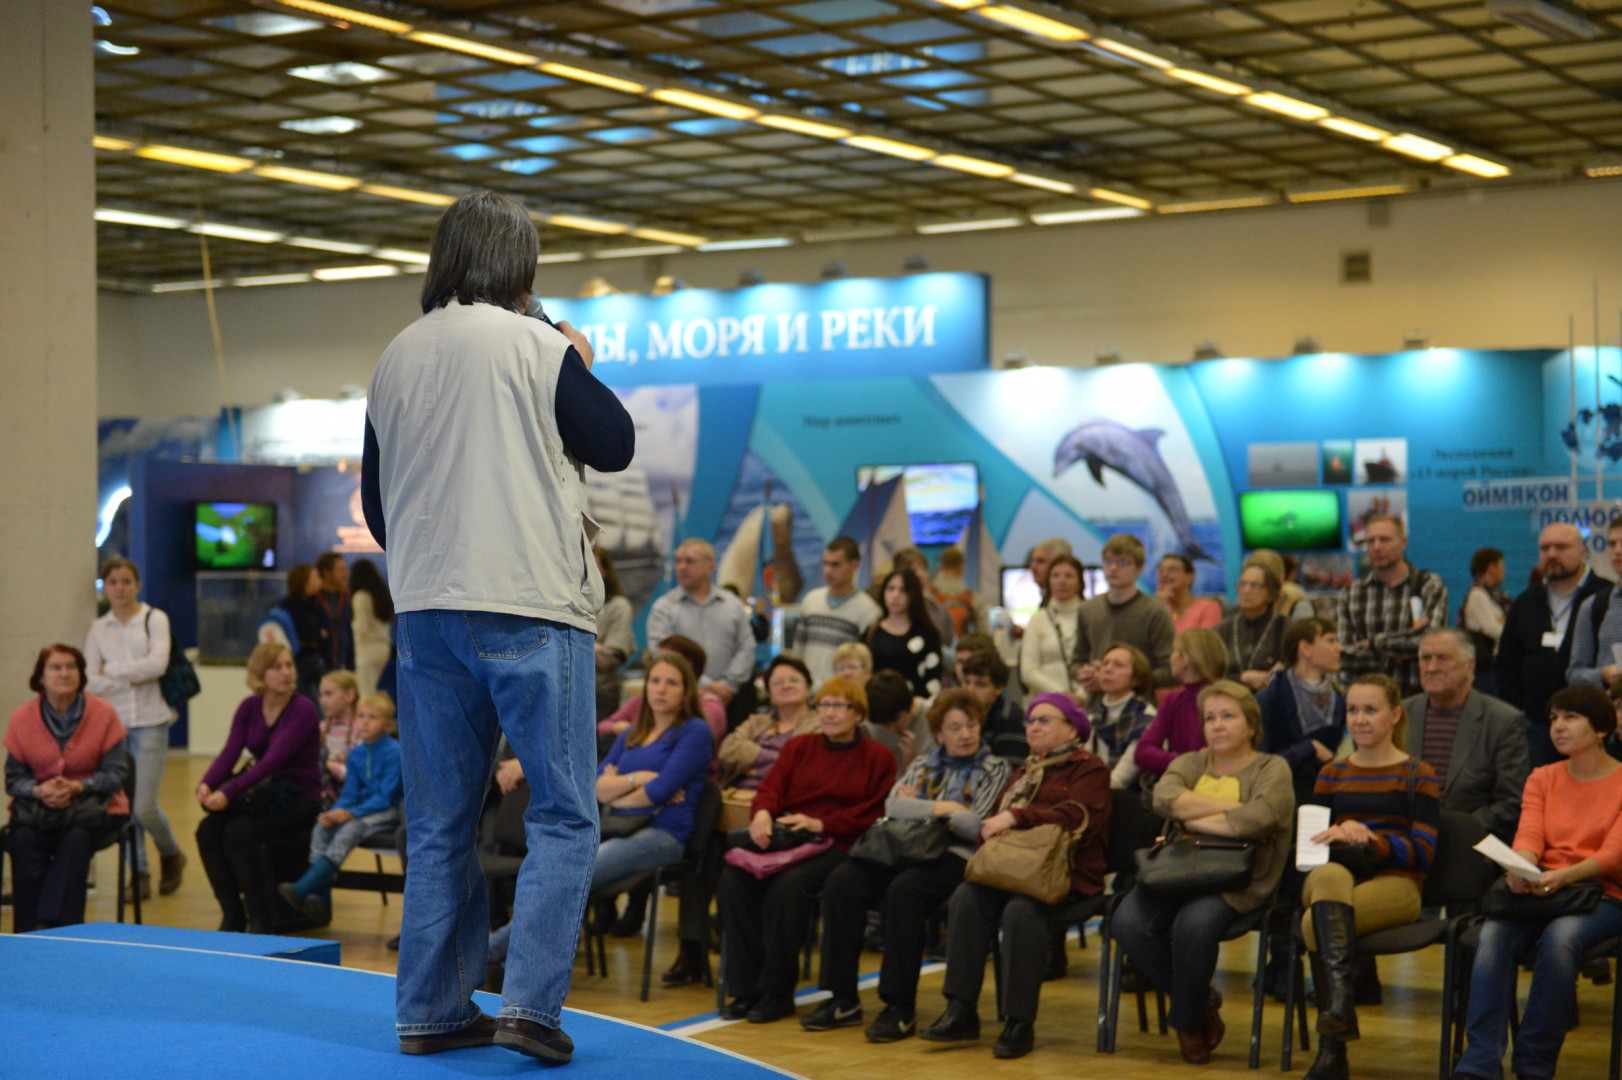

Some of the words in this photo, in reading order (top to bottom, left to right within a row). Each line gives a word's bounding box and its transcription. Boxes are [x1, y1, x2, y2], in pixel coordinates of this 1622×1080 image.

[580, 322, 638, 366] Ы,
[646, 314, 767, 360] МОРЯ
[776, 311, 809, 353] И
[819, 304, 937, 351] РЕКИ
[1463, 481, 1568, 507] ОЙМЯКОН
